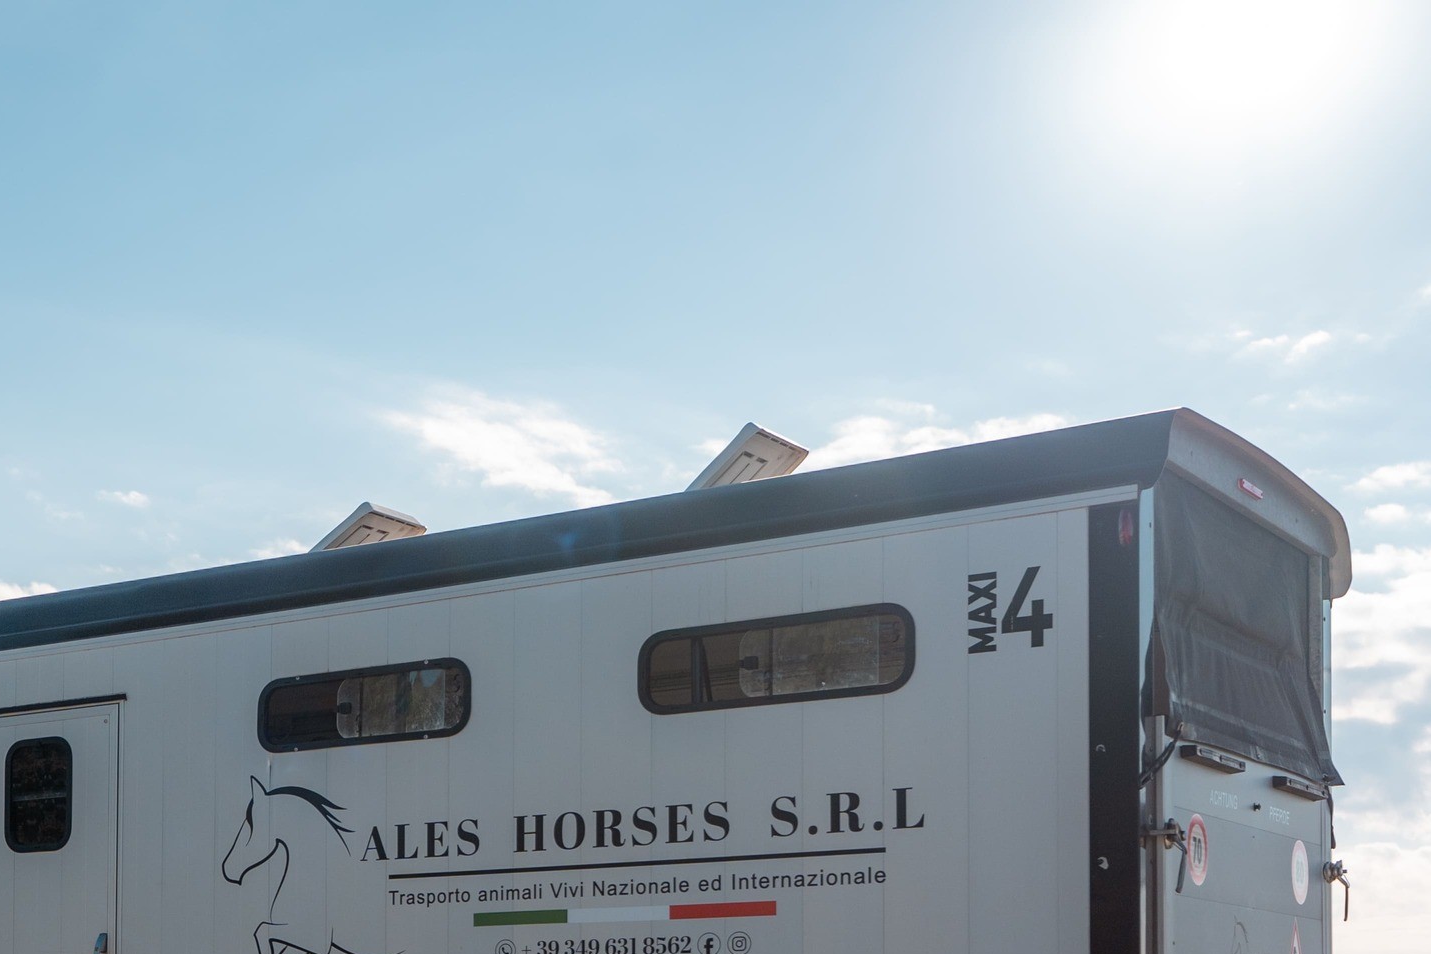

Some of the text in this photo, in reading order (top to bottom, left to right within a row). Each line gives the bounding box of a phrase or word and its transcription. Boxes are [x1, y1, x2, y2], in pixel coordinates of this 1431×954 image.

[968, 566, 1053, 654] MAXI 4
[360, 787, 925, 862] ALES HORSES S.R.L
[1209, 789, 1290, 825] ACHTUNG PFERDE
[1192, 836, 1202, 865] 70
[388, 866, 887, 907] Trasporto animali Vivi Nazionale ed Internazionale
[642, 935, 692, 954] 8562
